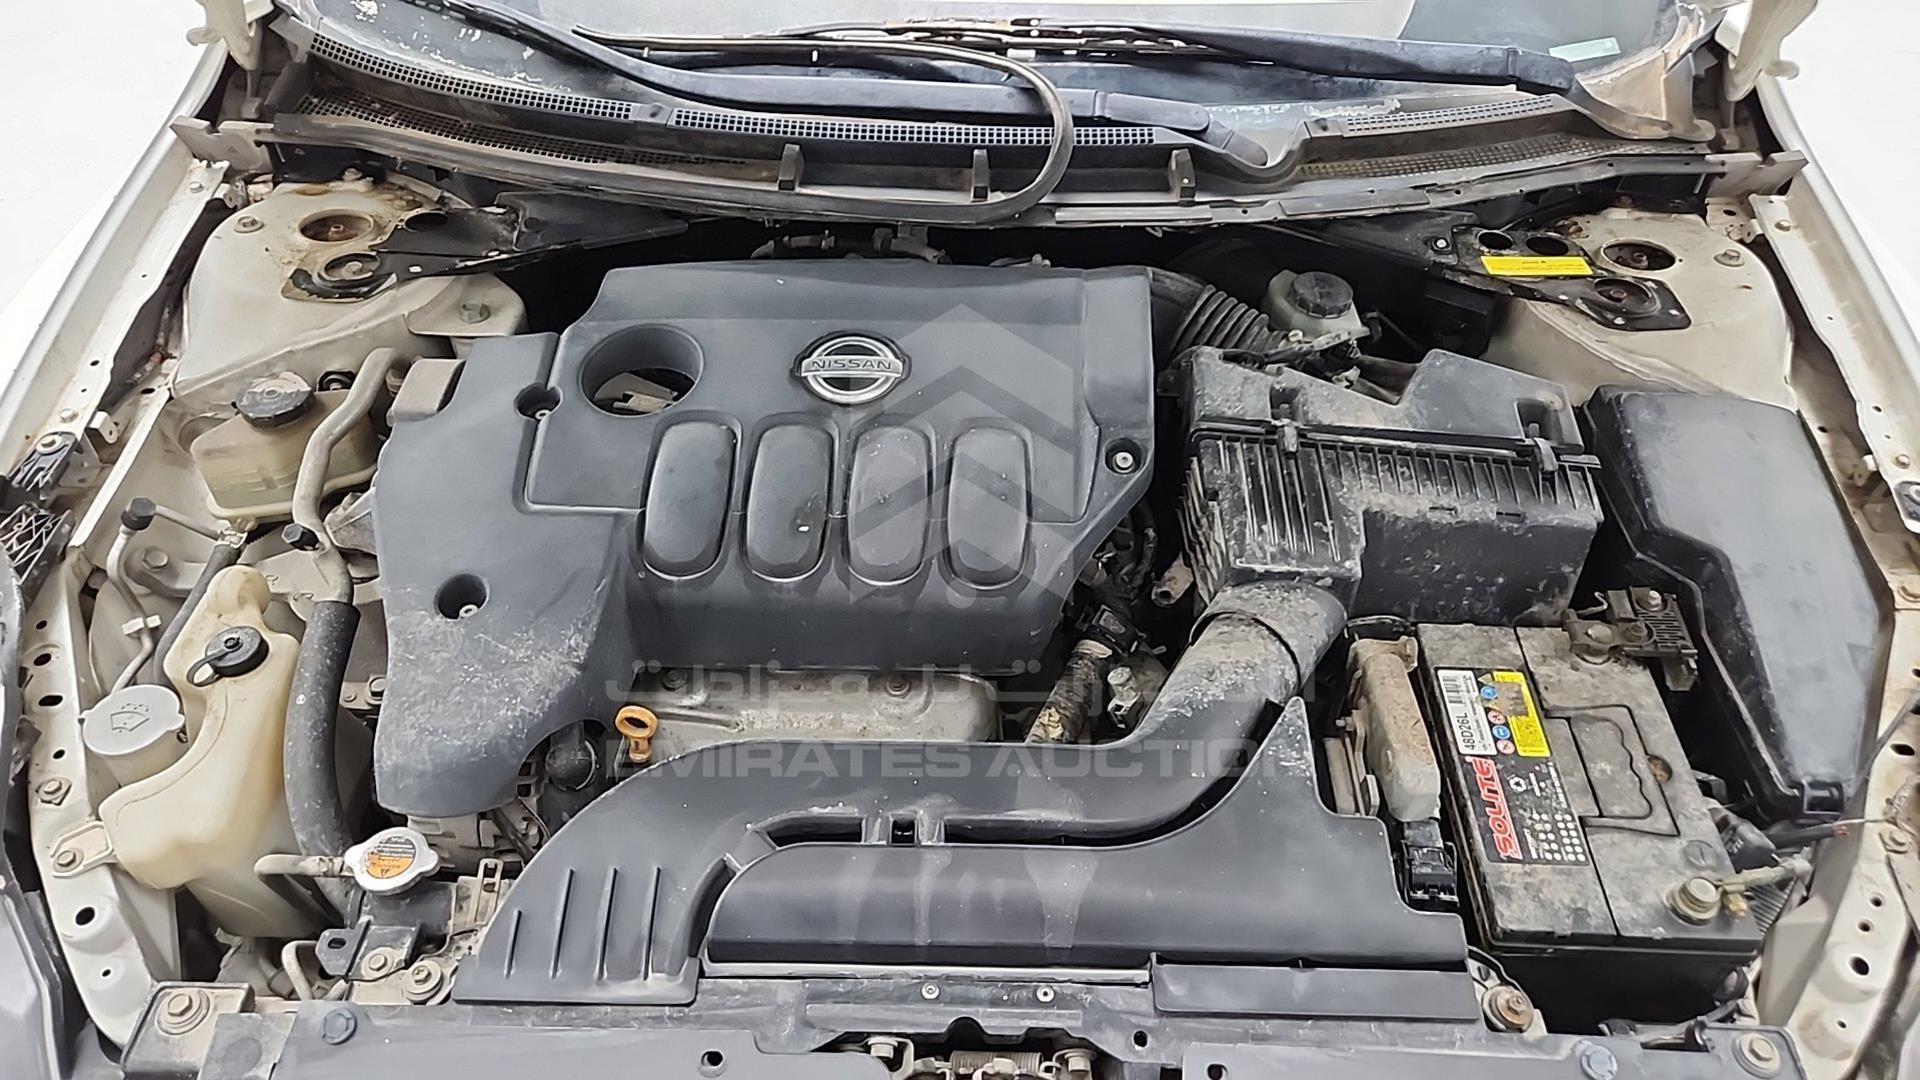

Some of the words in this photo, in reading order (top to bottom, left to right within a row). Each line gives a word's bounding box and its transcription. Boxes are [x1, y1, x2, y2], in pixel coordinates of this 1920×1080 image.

[812, 358, 892, 370] NISSAN
[1455, 711, 1476, 751] 48D26L
[1472, 756, 1522, 860] SOLITE
